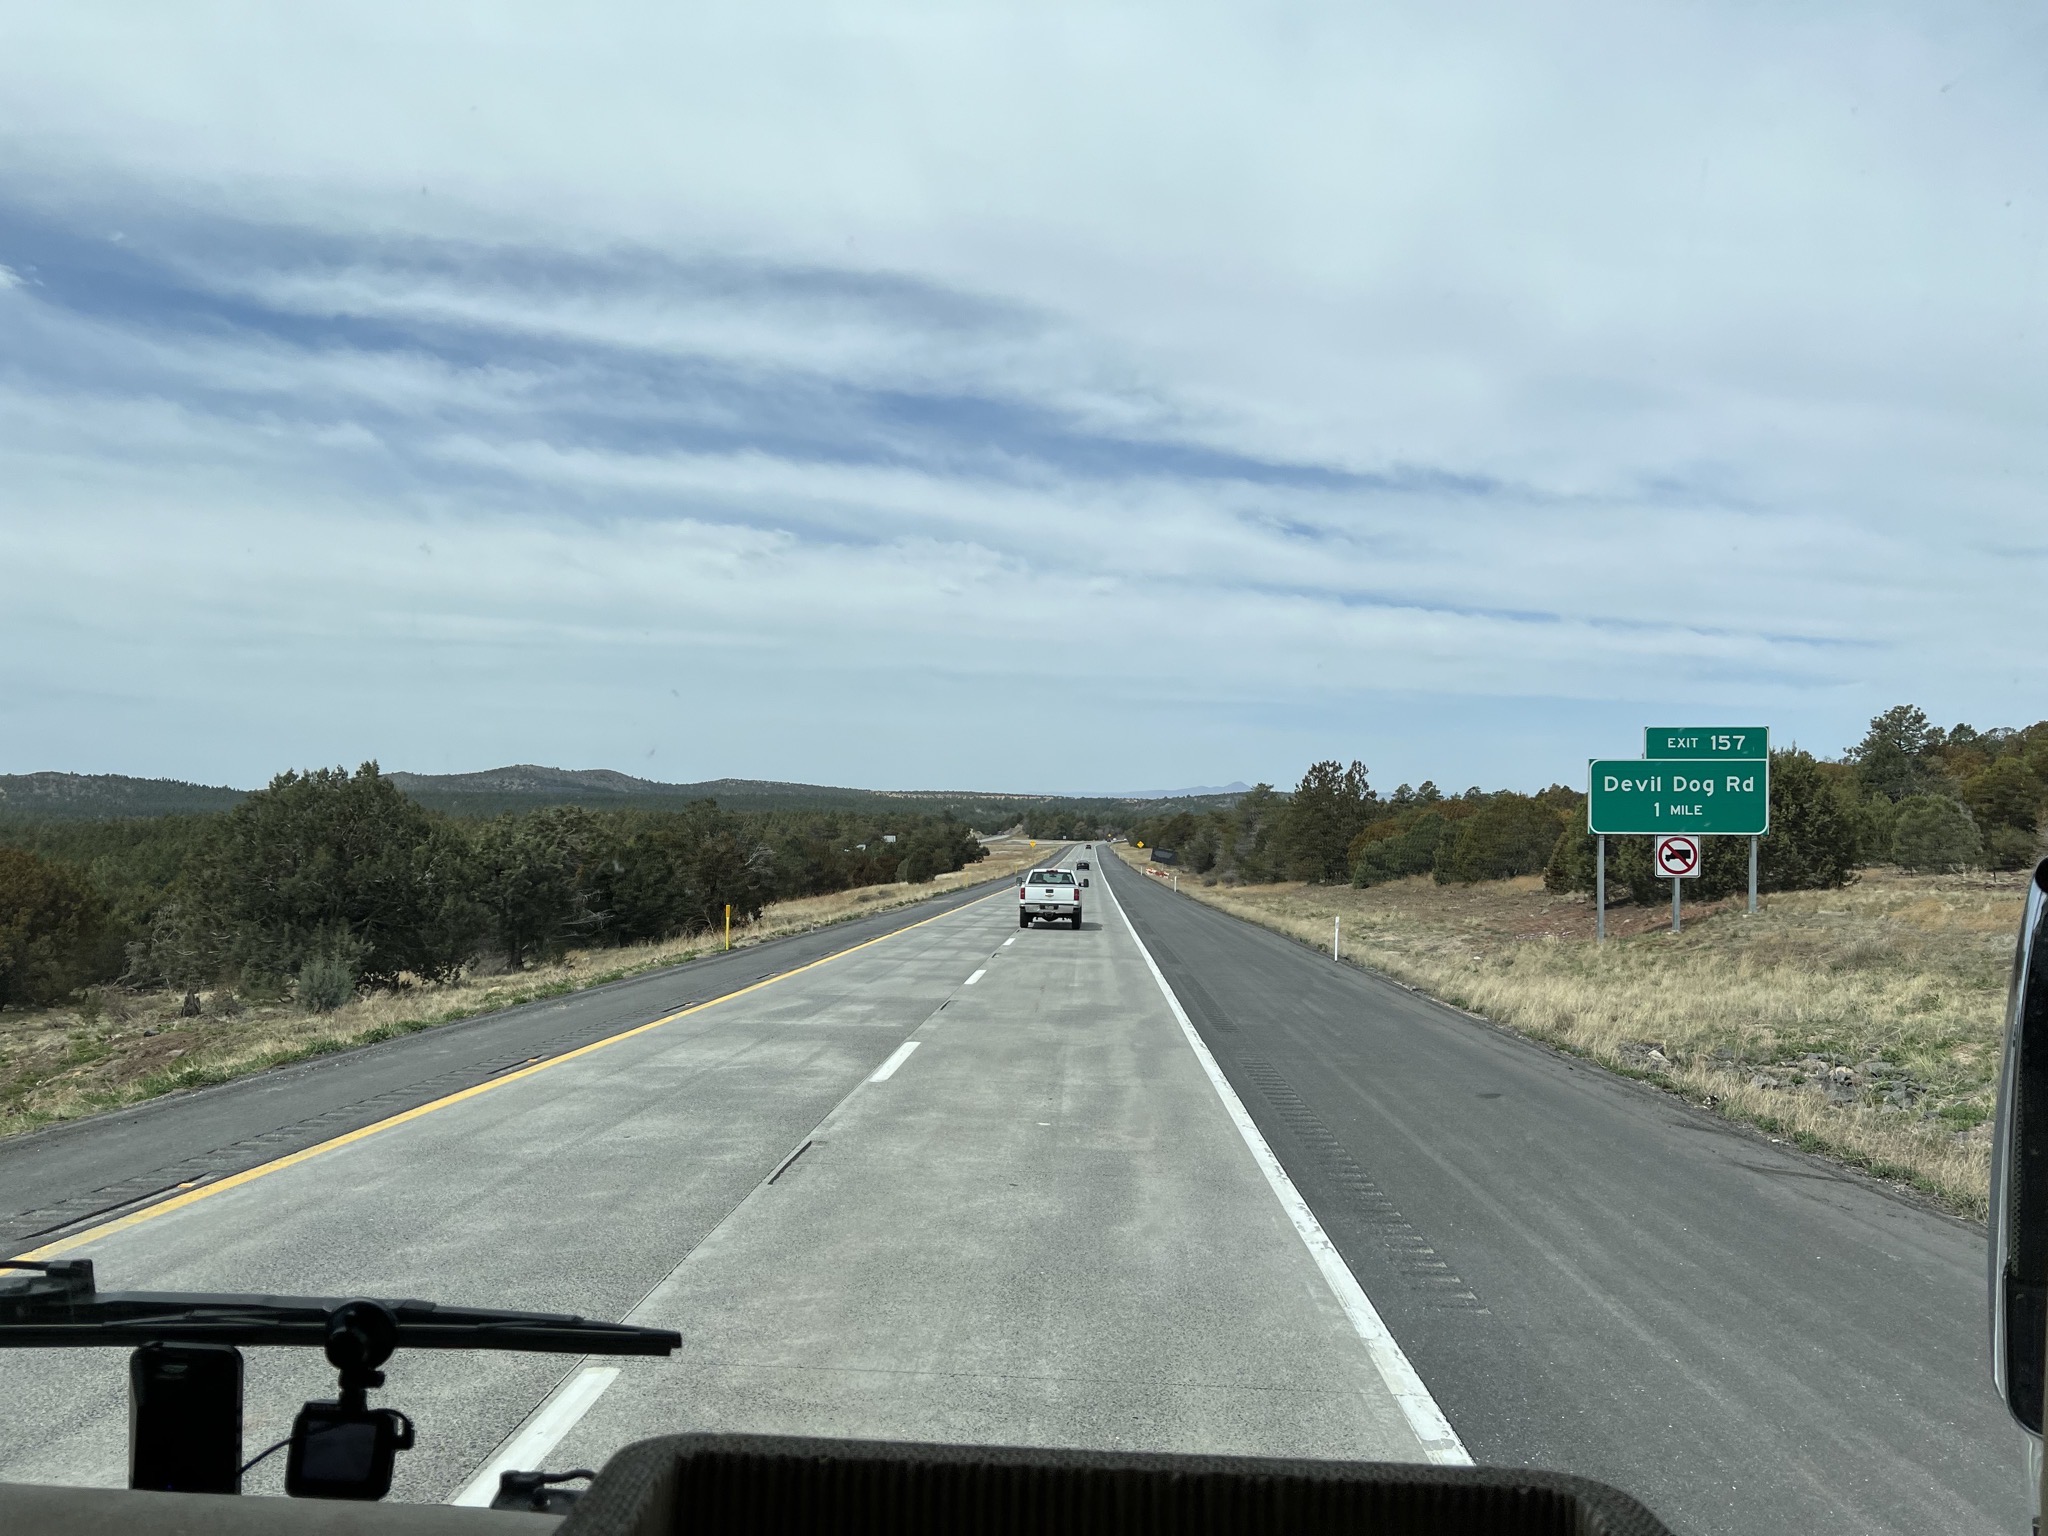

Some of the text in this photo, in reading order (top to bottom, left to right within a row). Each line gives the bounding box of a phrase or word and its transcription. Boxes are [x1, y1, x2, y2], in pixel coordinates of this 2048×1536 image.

[1667, 735, 1746, 751] EXIT 157
[1604, 775, 1754, 797] Devil Dog Rd
[1653, 802, 1703, 817] 1 MILE
